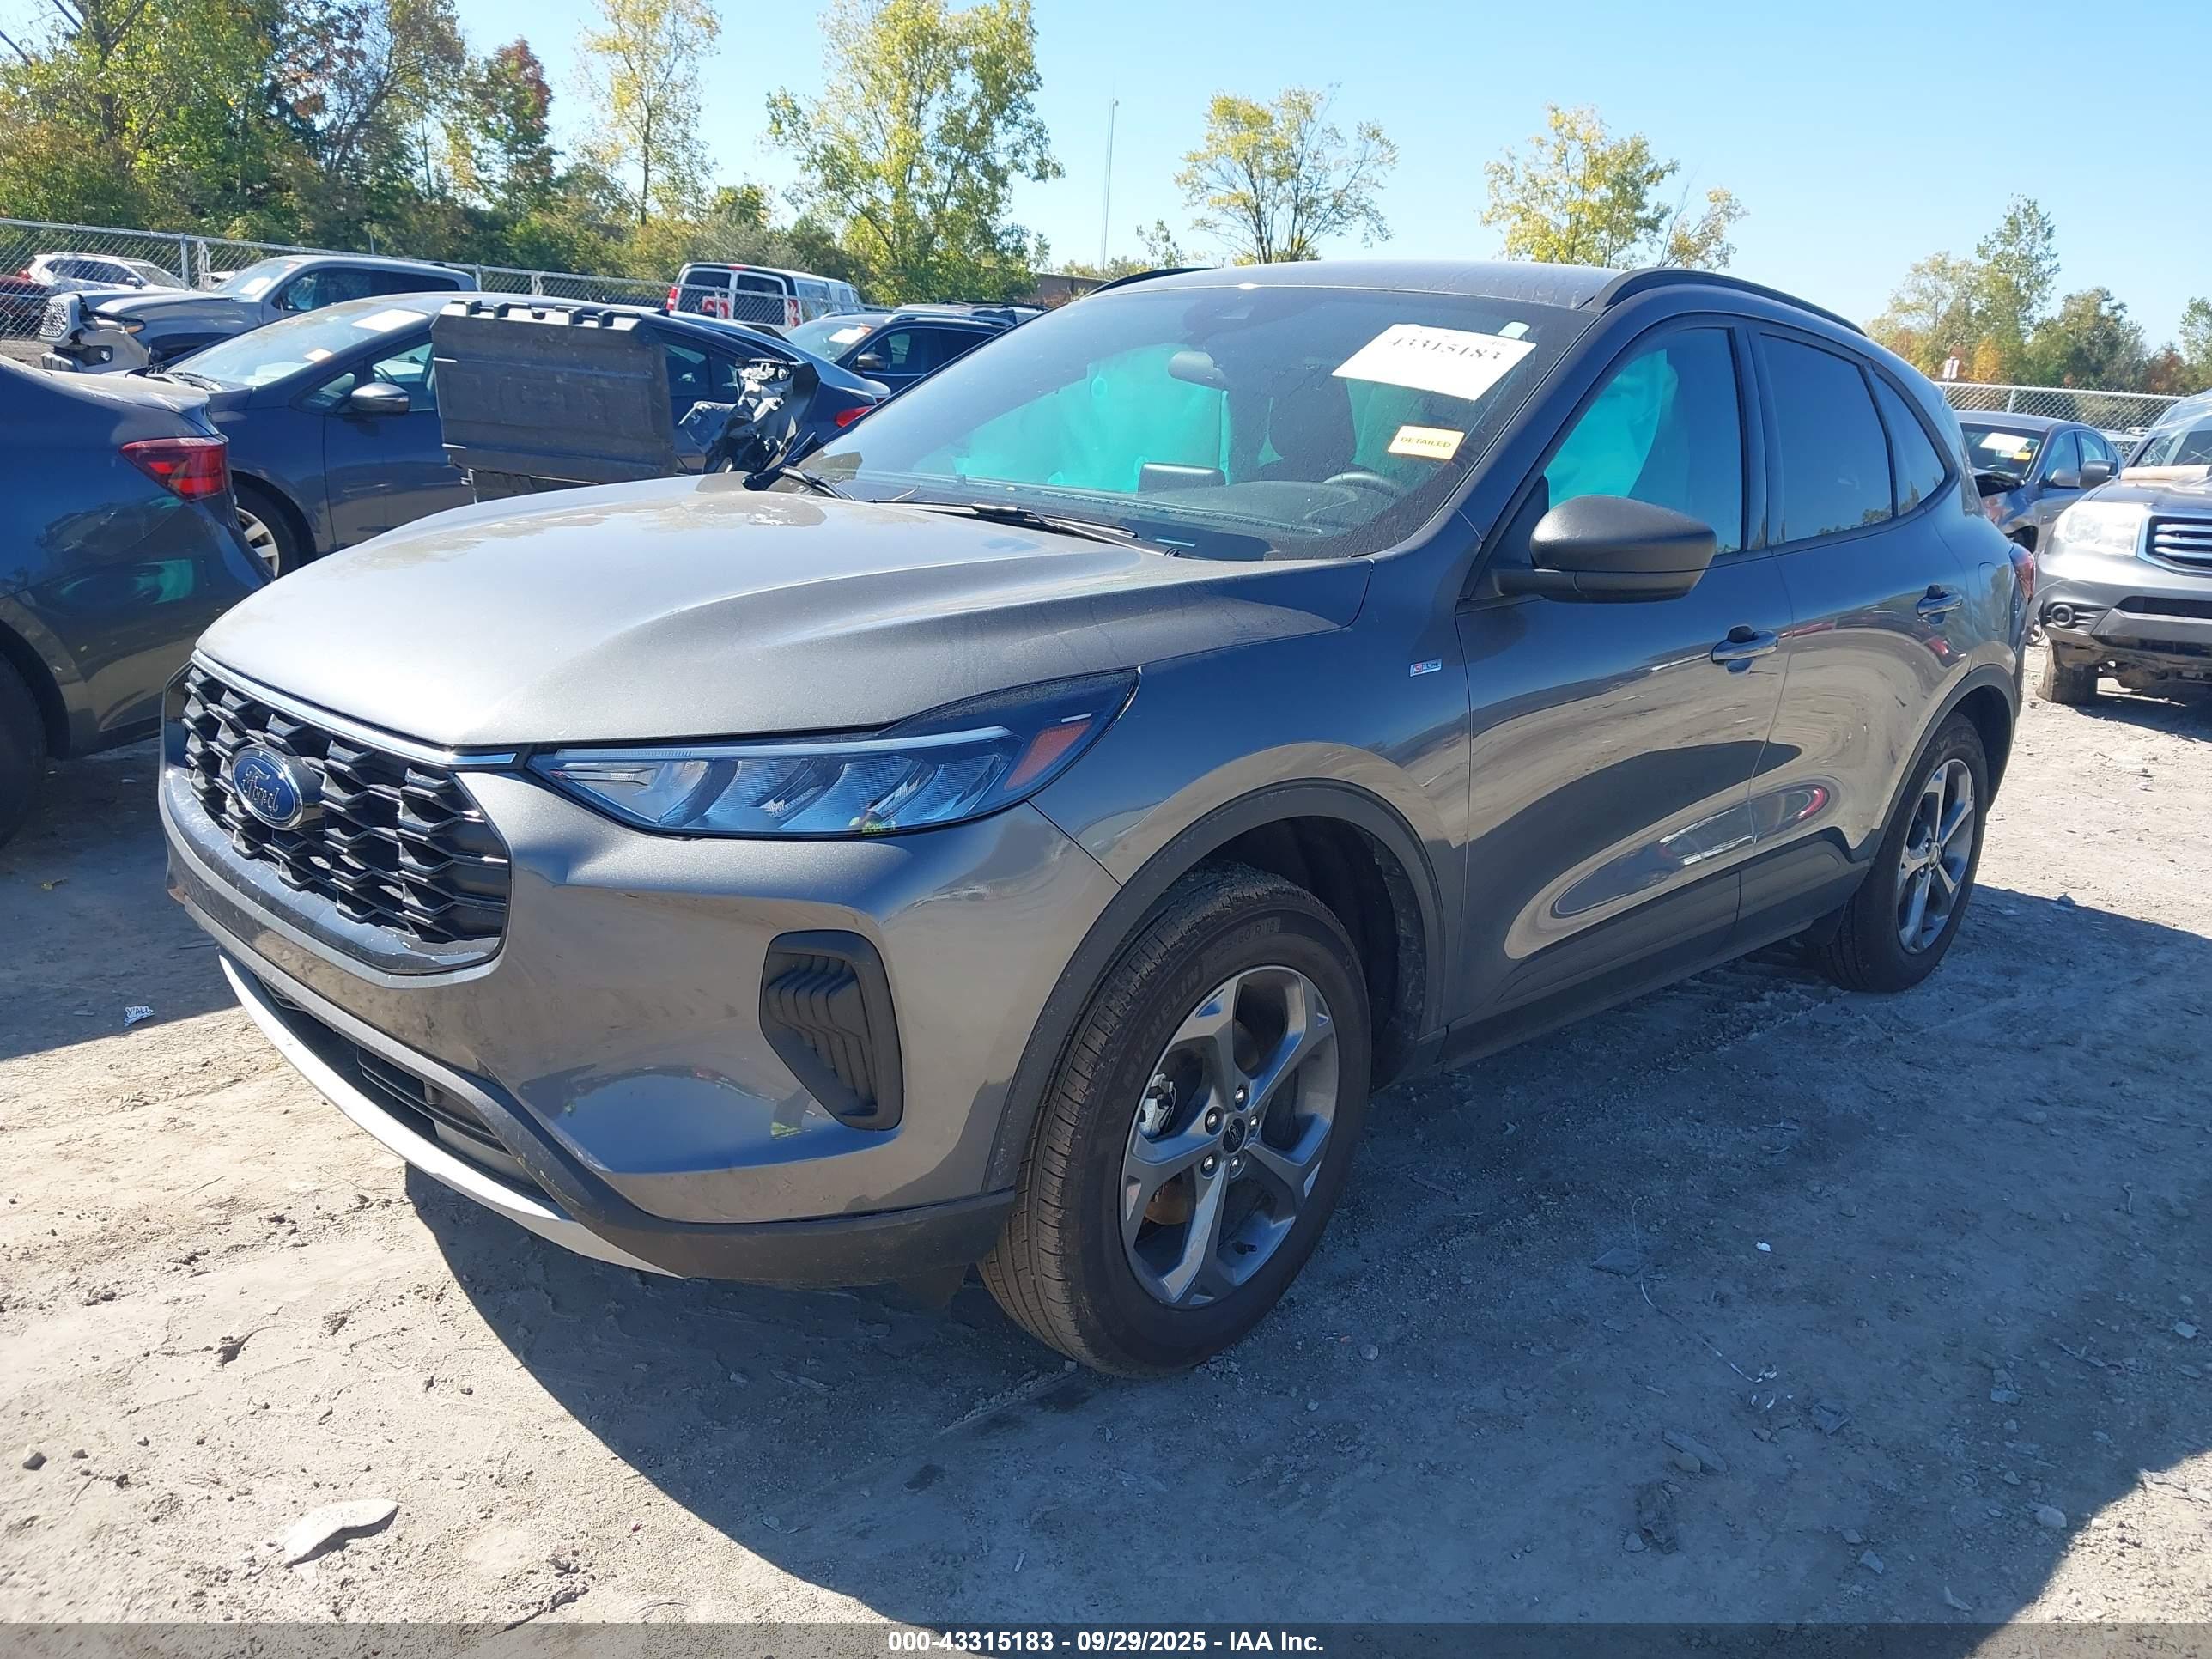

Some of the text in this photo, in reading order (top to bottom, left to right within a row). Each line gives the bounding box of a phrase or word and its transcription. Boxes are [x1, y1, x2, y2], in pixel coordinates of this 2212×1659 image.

[1400, 436, 1452, 447] DETAILED
[240, 763, 281, 817] Ford
[1123, 965, 1200, 1089] MICHELIN
